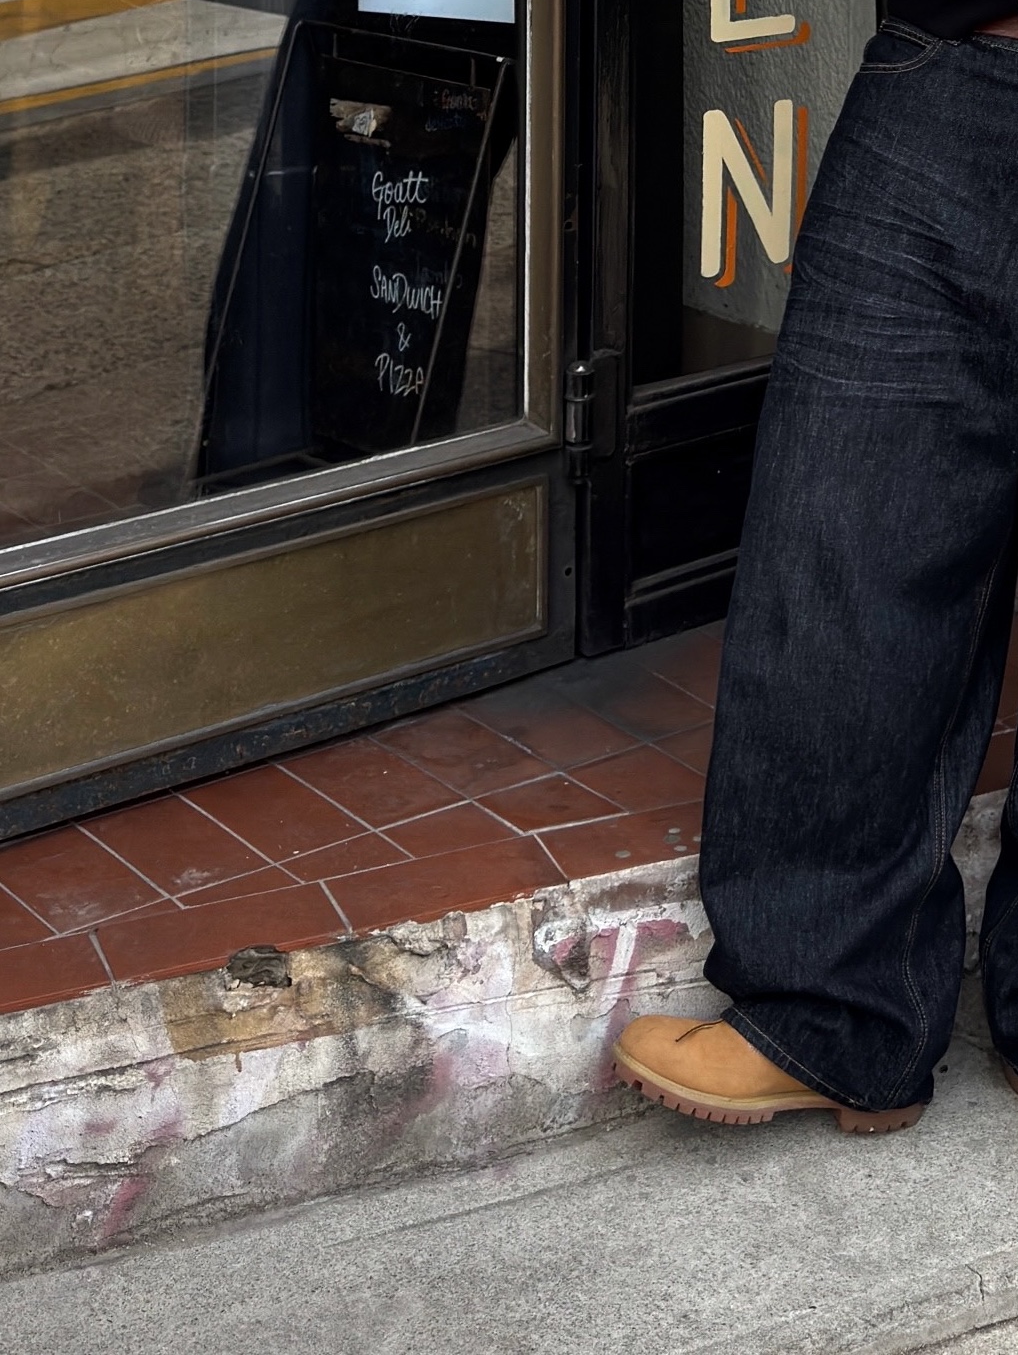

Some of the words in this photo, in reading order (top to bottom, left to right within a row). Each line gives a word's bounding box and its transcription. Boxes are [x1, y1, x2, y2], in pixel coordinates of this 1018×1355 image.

[372, 171, 429, 220] Goatt
[383, 206, 414, 244] Deli
[370, 265, 443, 320] SANDWICH
[397, 323, 411, 351] &
[374, 353, 425, 396] PIZZA
